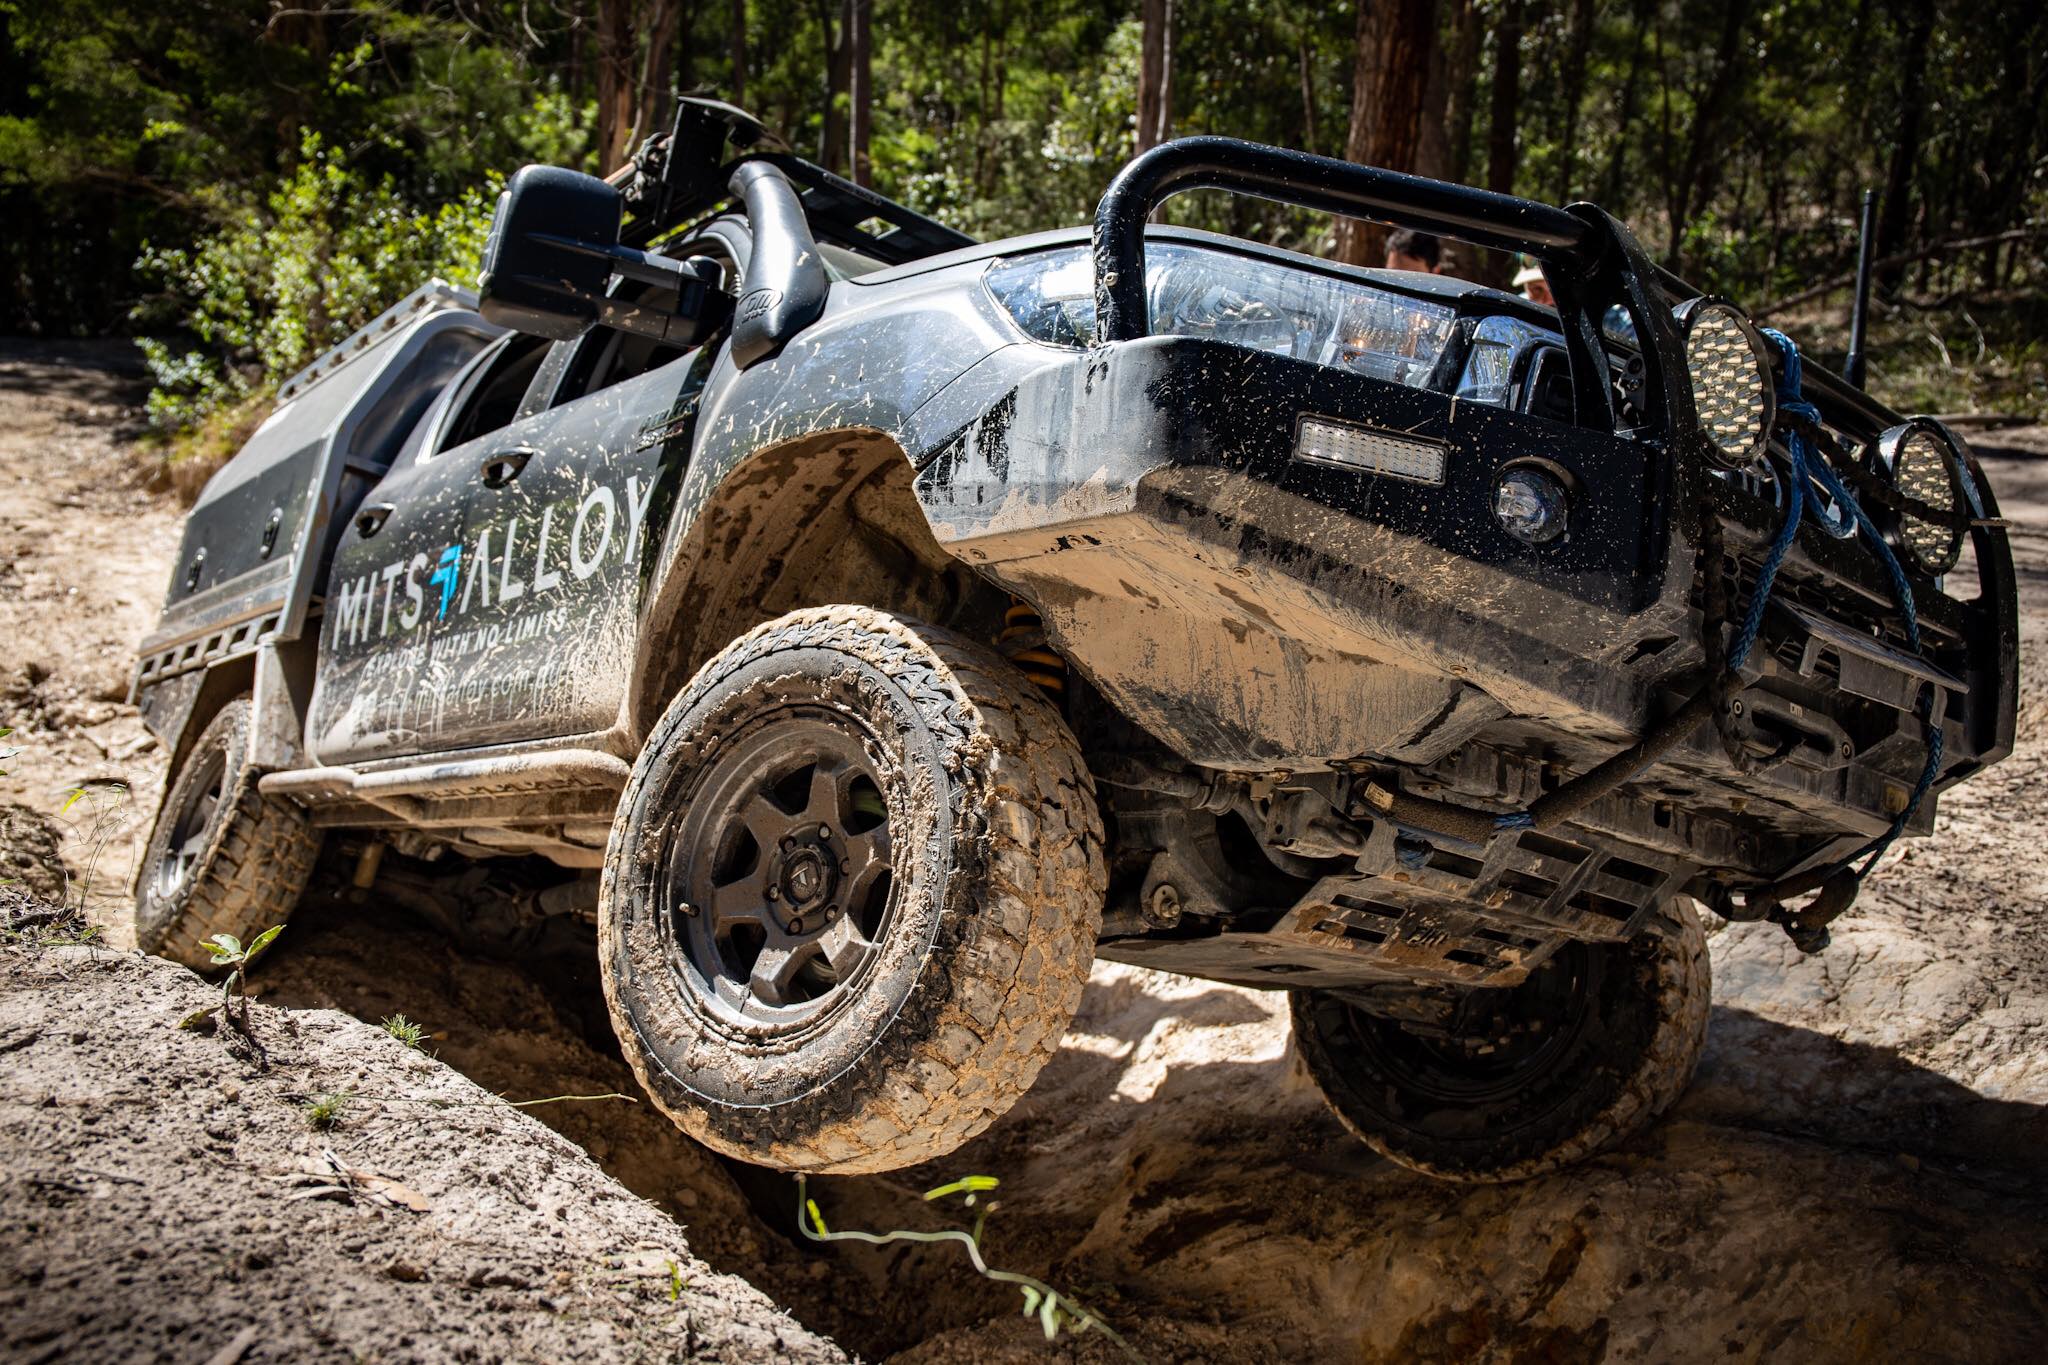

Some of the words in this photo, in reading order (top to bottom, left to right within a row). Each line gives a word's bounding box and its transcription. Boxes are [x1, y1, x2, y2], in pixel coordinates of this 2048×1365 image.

[332, 552, 429, 650] MITS
[459, 465, 666, 615] ALLOY
[431, 627, 470, 661] WITH
[473, 623, 501, 652] NO
[507, 605, 568, 644] LIMITS
